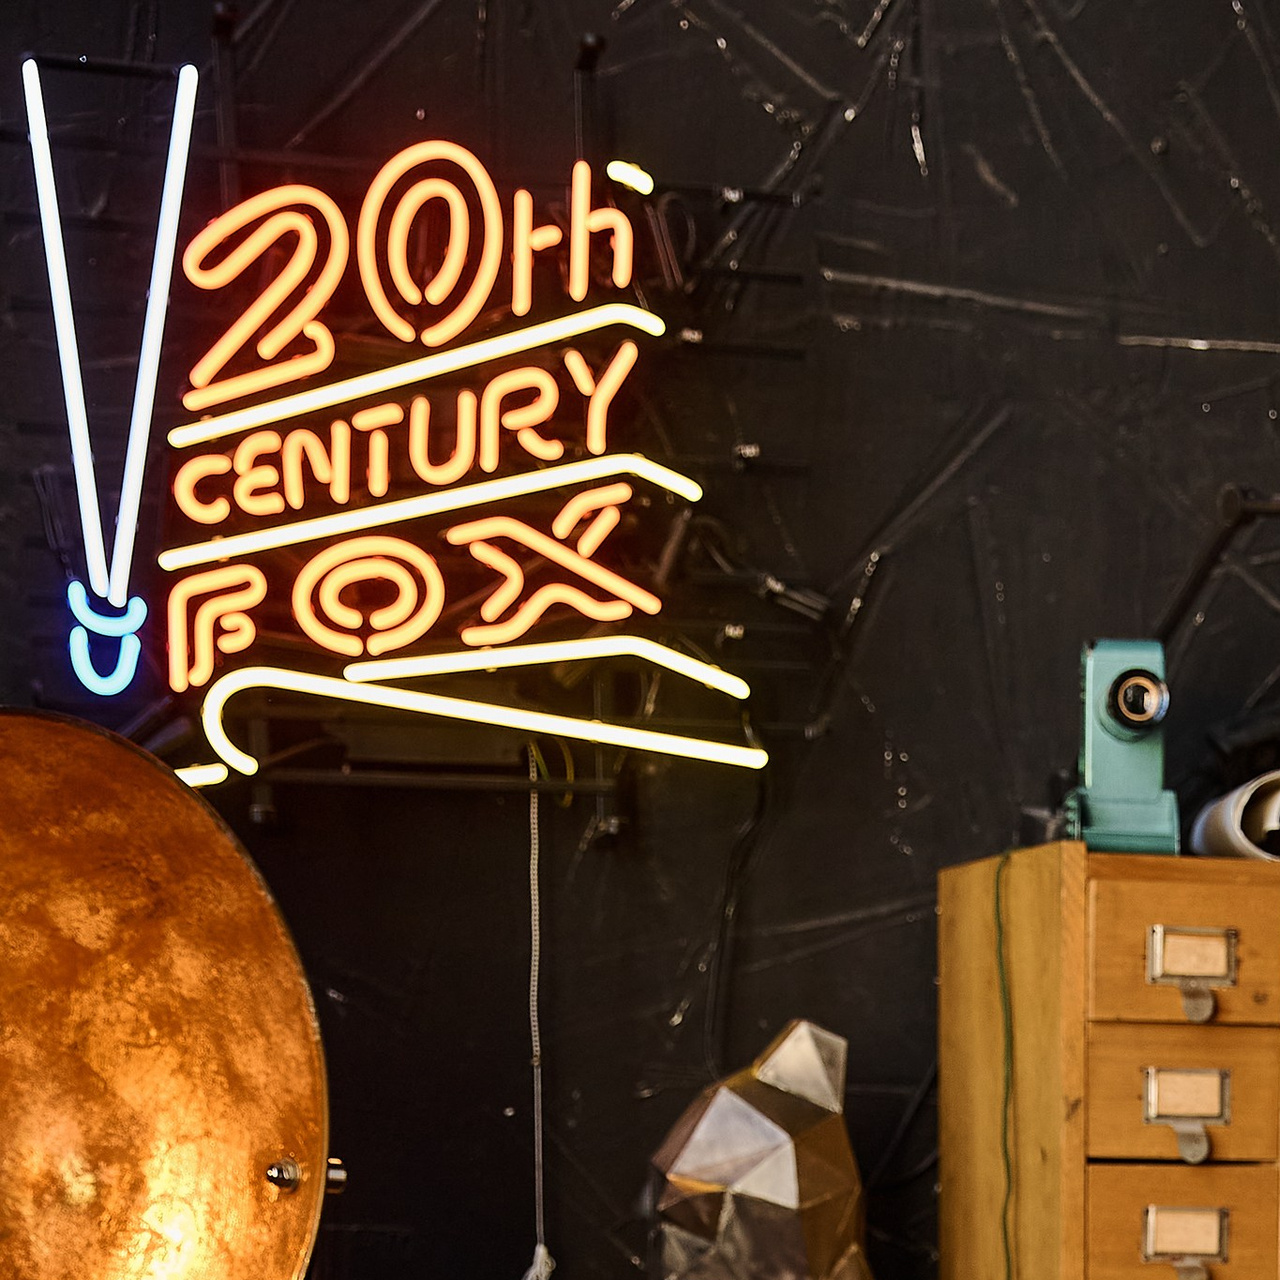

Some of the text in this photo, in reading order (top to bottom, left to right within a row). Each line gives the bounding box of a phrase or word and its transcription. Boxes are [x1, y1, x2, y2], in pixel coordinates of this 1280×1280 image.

[183, 139, 634, 412] 20th
[174, 341, 639, 525] CENTURY
[169, 483, 663, 693] FOX
